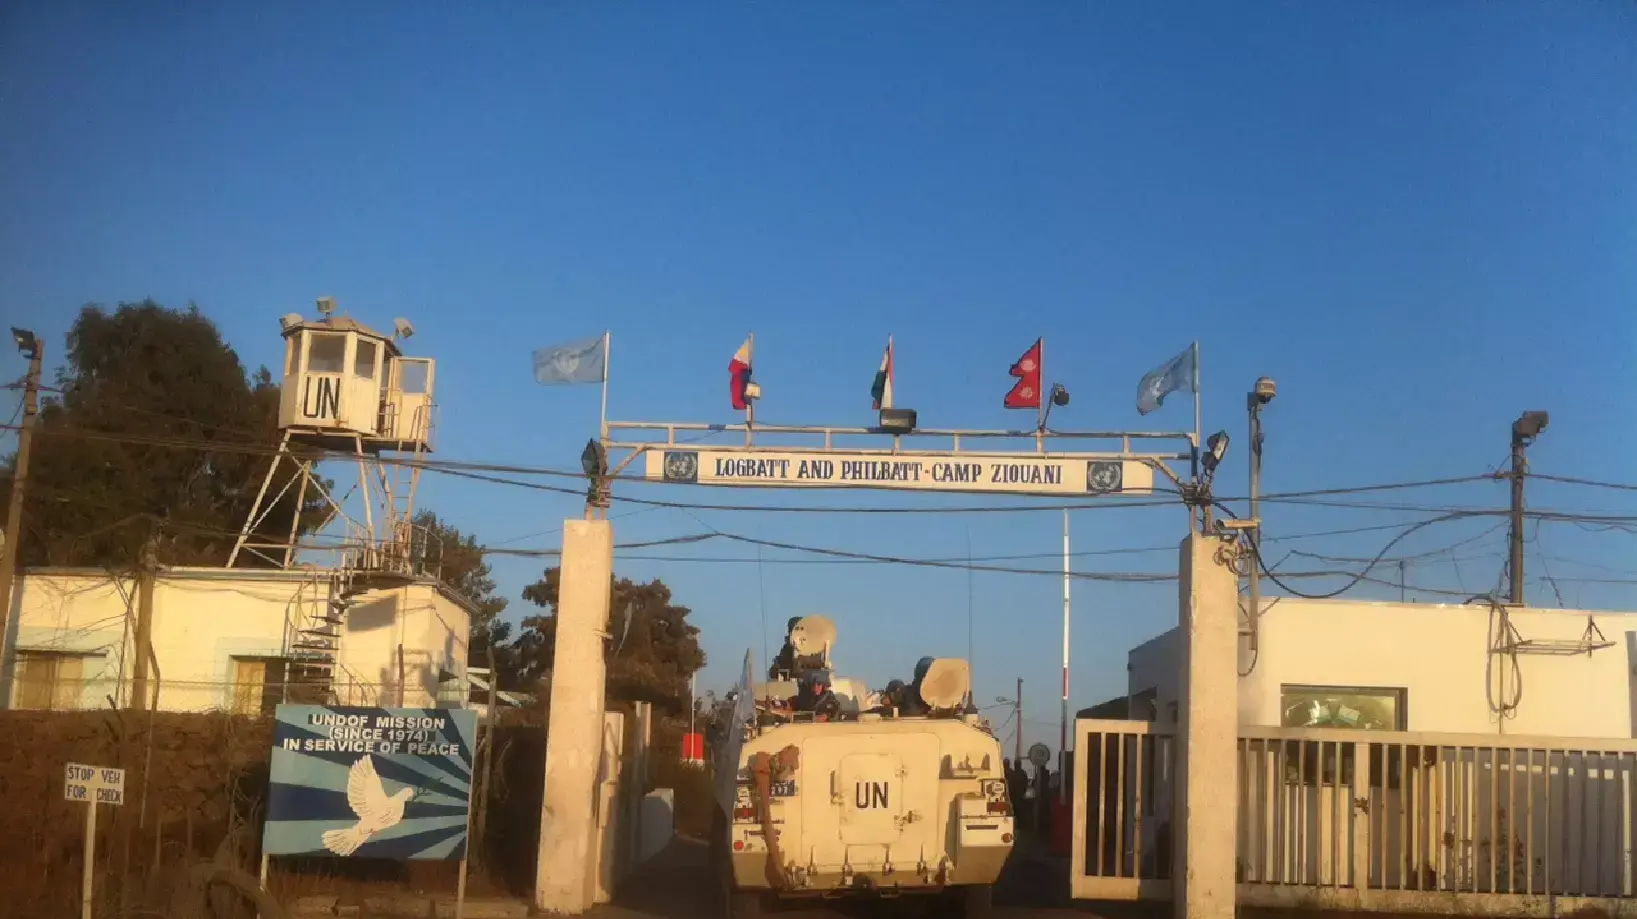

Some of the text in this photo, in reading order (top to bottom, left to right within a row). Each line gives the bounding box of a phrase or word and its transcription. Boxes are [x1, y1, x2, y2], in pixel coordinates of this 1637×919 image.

[303, 376, 341, 419] UN
[715, 458, 790, 479] LOGBATT
[797, 460, 834, 479] AND
[991, 464, 1063, 484] ZIOUANI
[311, 714, 445, 729] UNDOF MISSION
[329, 727, 429, 742] (SINCE 1974)
[283, 738, 460, 756] IN SERVICE OF PEACE
[67, 765, 95, 781] STOP
[67, 784, 87, 799] FOR
[856, 781, 889, 809] UN
